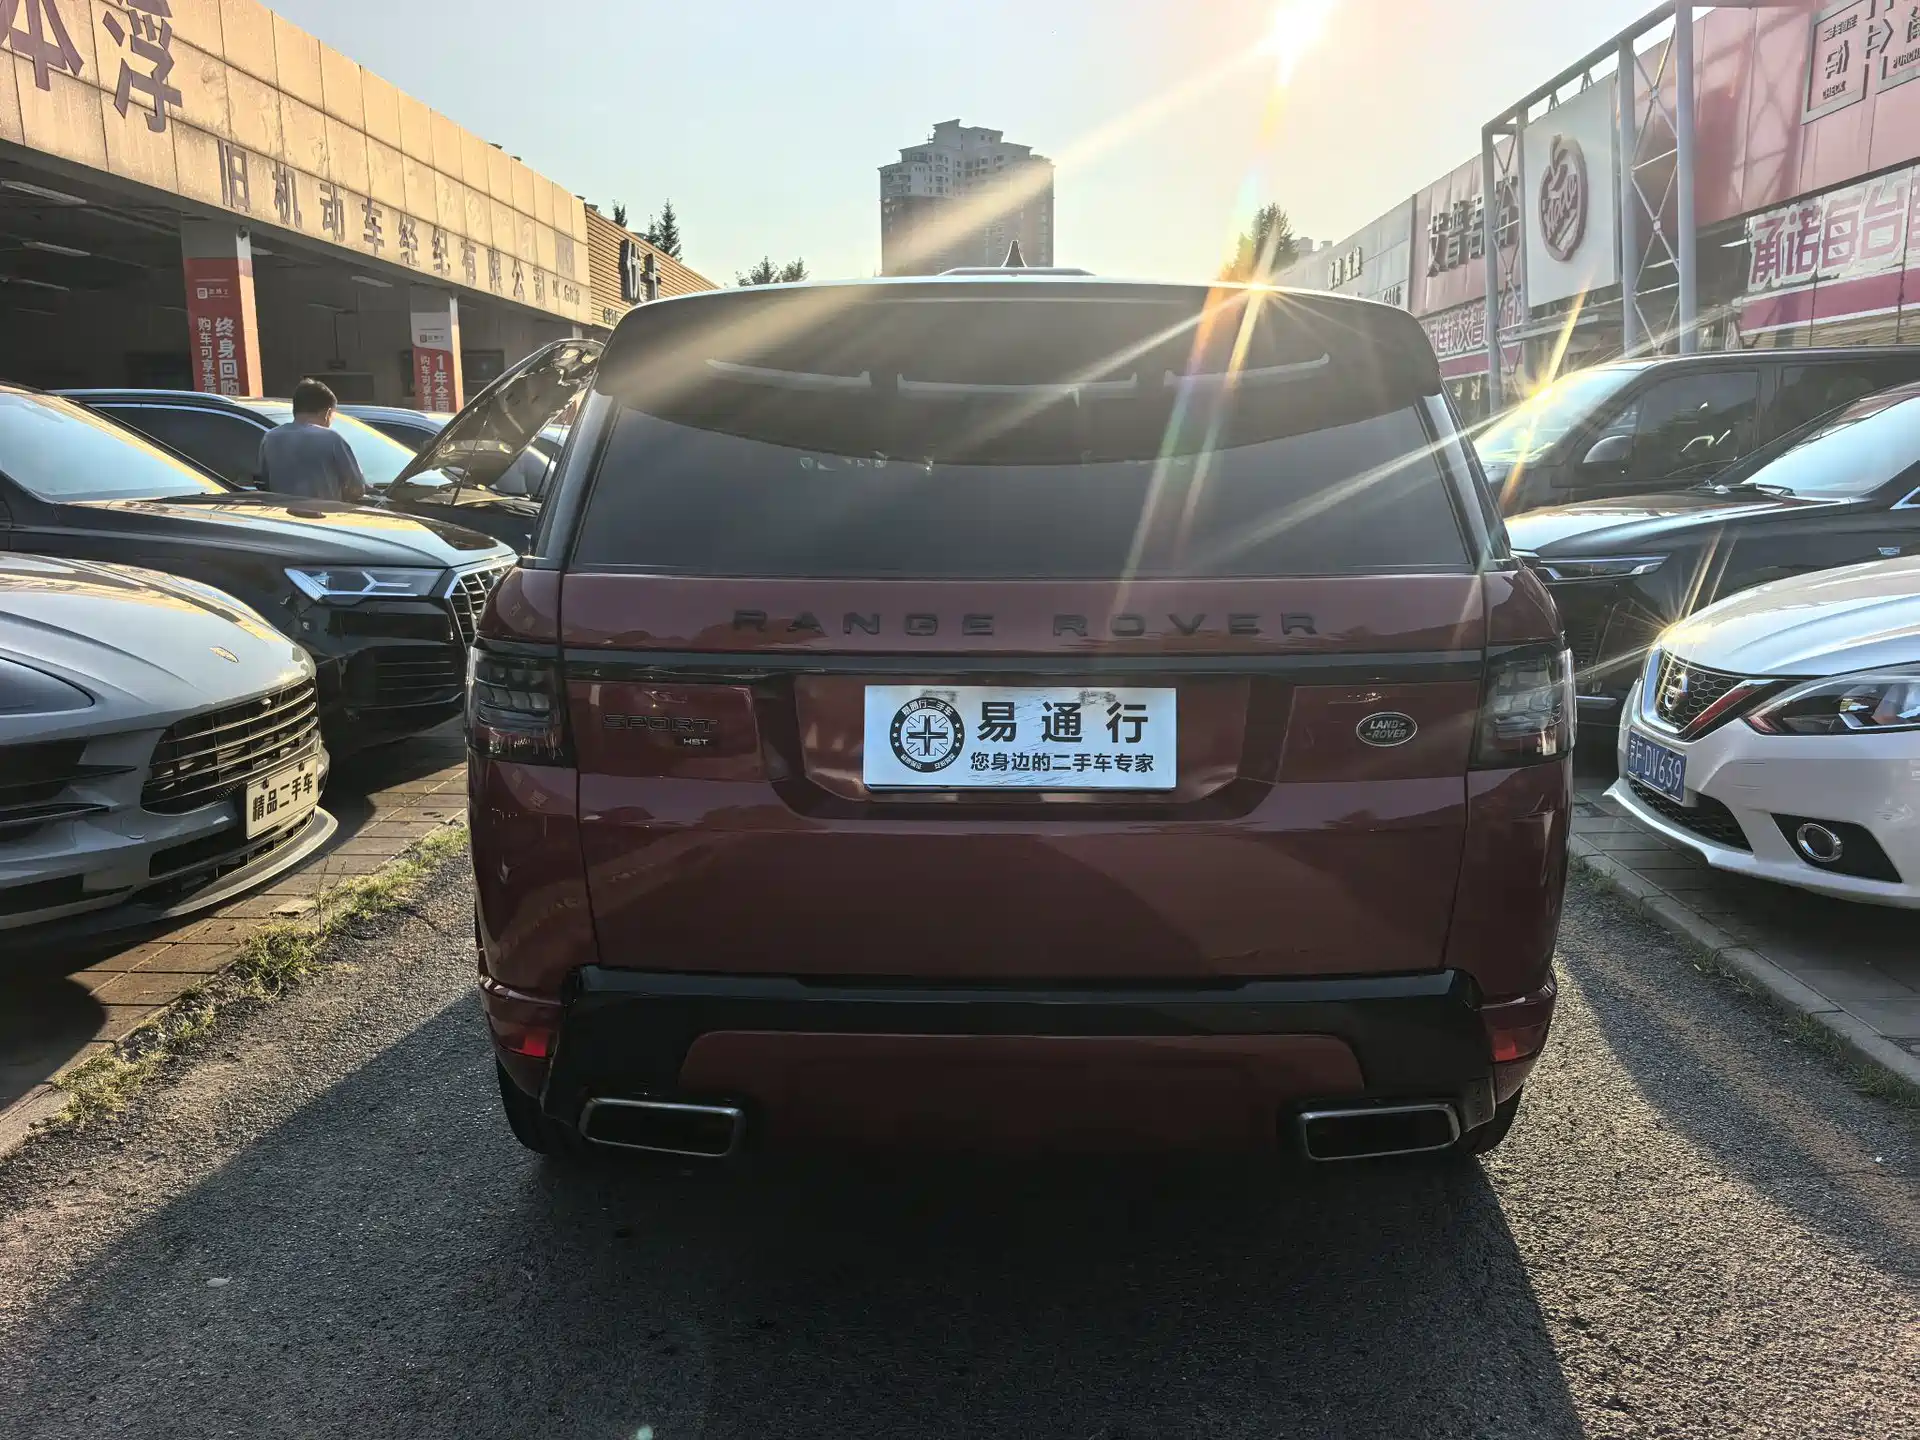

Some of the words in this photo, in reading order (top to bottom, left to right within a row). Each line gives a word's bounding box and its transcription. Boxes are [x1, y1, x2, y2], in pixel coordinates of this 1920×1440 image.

[733, 609, 995, 637] RANGE
[1052, 612, 1319, 637] ROVER
[603, 714, 720, 733] SPORT
[977, 701, 1148, 744] 易通行
[970, 752, 1154, 773] 您身边的二手车专家
[252, 773, 313, 822] 精品二手车
